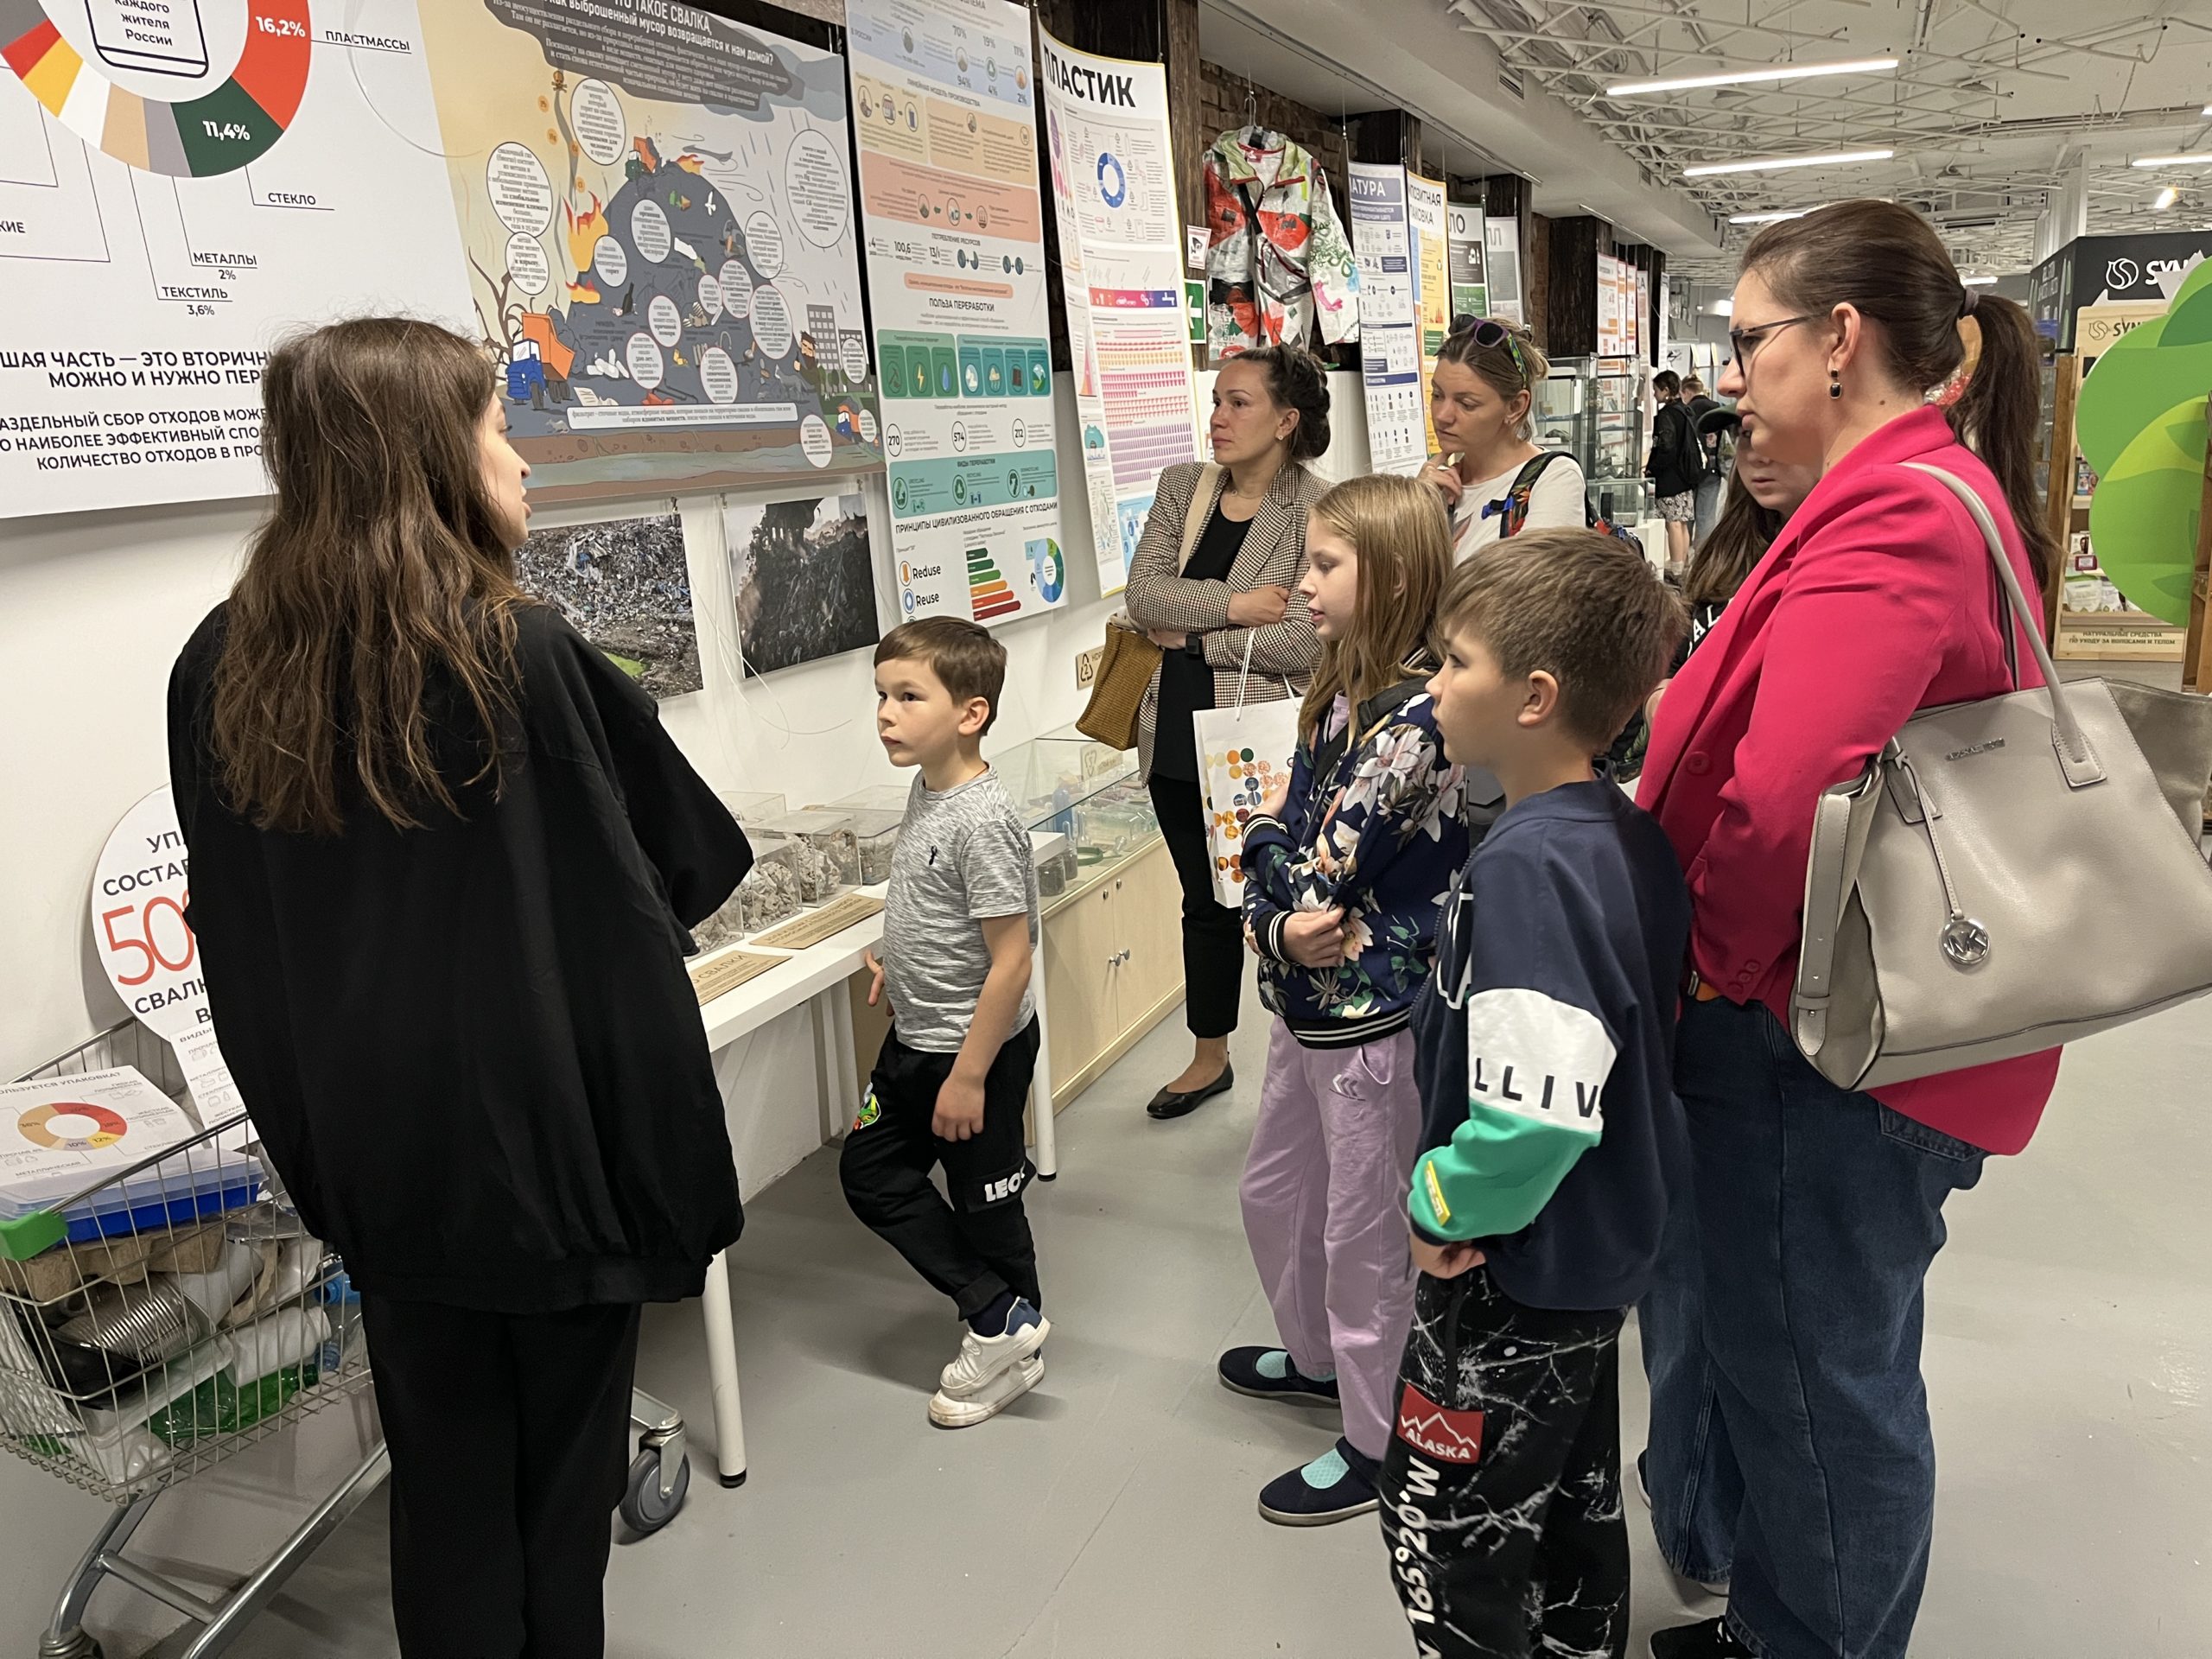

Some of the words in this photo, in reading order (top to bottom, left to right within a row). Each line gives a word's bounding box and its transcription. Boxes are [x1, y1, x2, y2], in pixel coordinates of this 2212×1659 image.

[120, 13, 170, 30] жителя
[255, 16, 307, 37] 16,2%
[670, 4, 713, 35] СВАЛКА,
[124, 29, 173, 47] России
[325, 30, 411, 51] ПЛАСТМАССЫ
[952, 25, 967, 40] 70%
[639, 16, 666, 37] мусор
[667, 25, 724, 52] возвращается
[725, 42, 730, 54] к
[730, 44, 747, 59] нам
[747, 49, 774, 67] домой?
[957, 75, 972, 89] 94%
[1043, 43, 1136, 108] ПЛАСТИК
[202, 120, 251, 141] 11,4%
[268, 192, 316, 206] СТЕКЛО
[893, 240, 912, 254] 100,6
[193, 251, 258, 266] МЕТАЛЛЫ
[218, 268, 237, 281] 2%
[162, 286, 228, 301] ТЕКСТИЛЬ
[186, 304, 216, 317] 3,6%
[929, 297, 953, 309] ПОЛЬЗА
[953, 301, 995, 312] ПЕРЕРАБОТКИ
[50, 352, 116, 367] ЧАСТЬ
[143, 352, 178, 366] ЭТО
[48, 371, 127, 388] МОЖНО
[132, 371, 145, 386] И
[150, 370, 221, 386] НУЖНО
[103, 412, 145, 429] СБОР
[149, 410, 221, 427] ОТХОДОВ
[16, 434, 104, 450] НАИБОЛЕЕ
[107, 425, 225, 447] ЭФФЕКТИВНЫЙ
[887, 435, 900, 447] 270
[953, 432, 964, 442] 574
[36, 451, 143, 470] КОЛИЧЕСТВО
[145, 448, 217, 464] ОТХОДОВ
[219, 446, 231, 458] В
[895, 520, 931, 534] ПРИНЦИПЫ
[932, 512, 990, 531] ЦИВИЛИЗОВАННОГО
[990, 508, 1024, 520] ОБРАЩЕНИЯ
[1030, 502, 1058, 514] ОТХОДАМИ
[912, 564, 941, 580] Reduse
[915, 592, 940, 607] Reuse
[146, 830, 187, 854] УП
[1405, 1427, 1471, 1460] ALASKA
